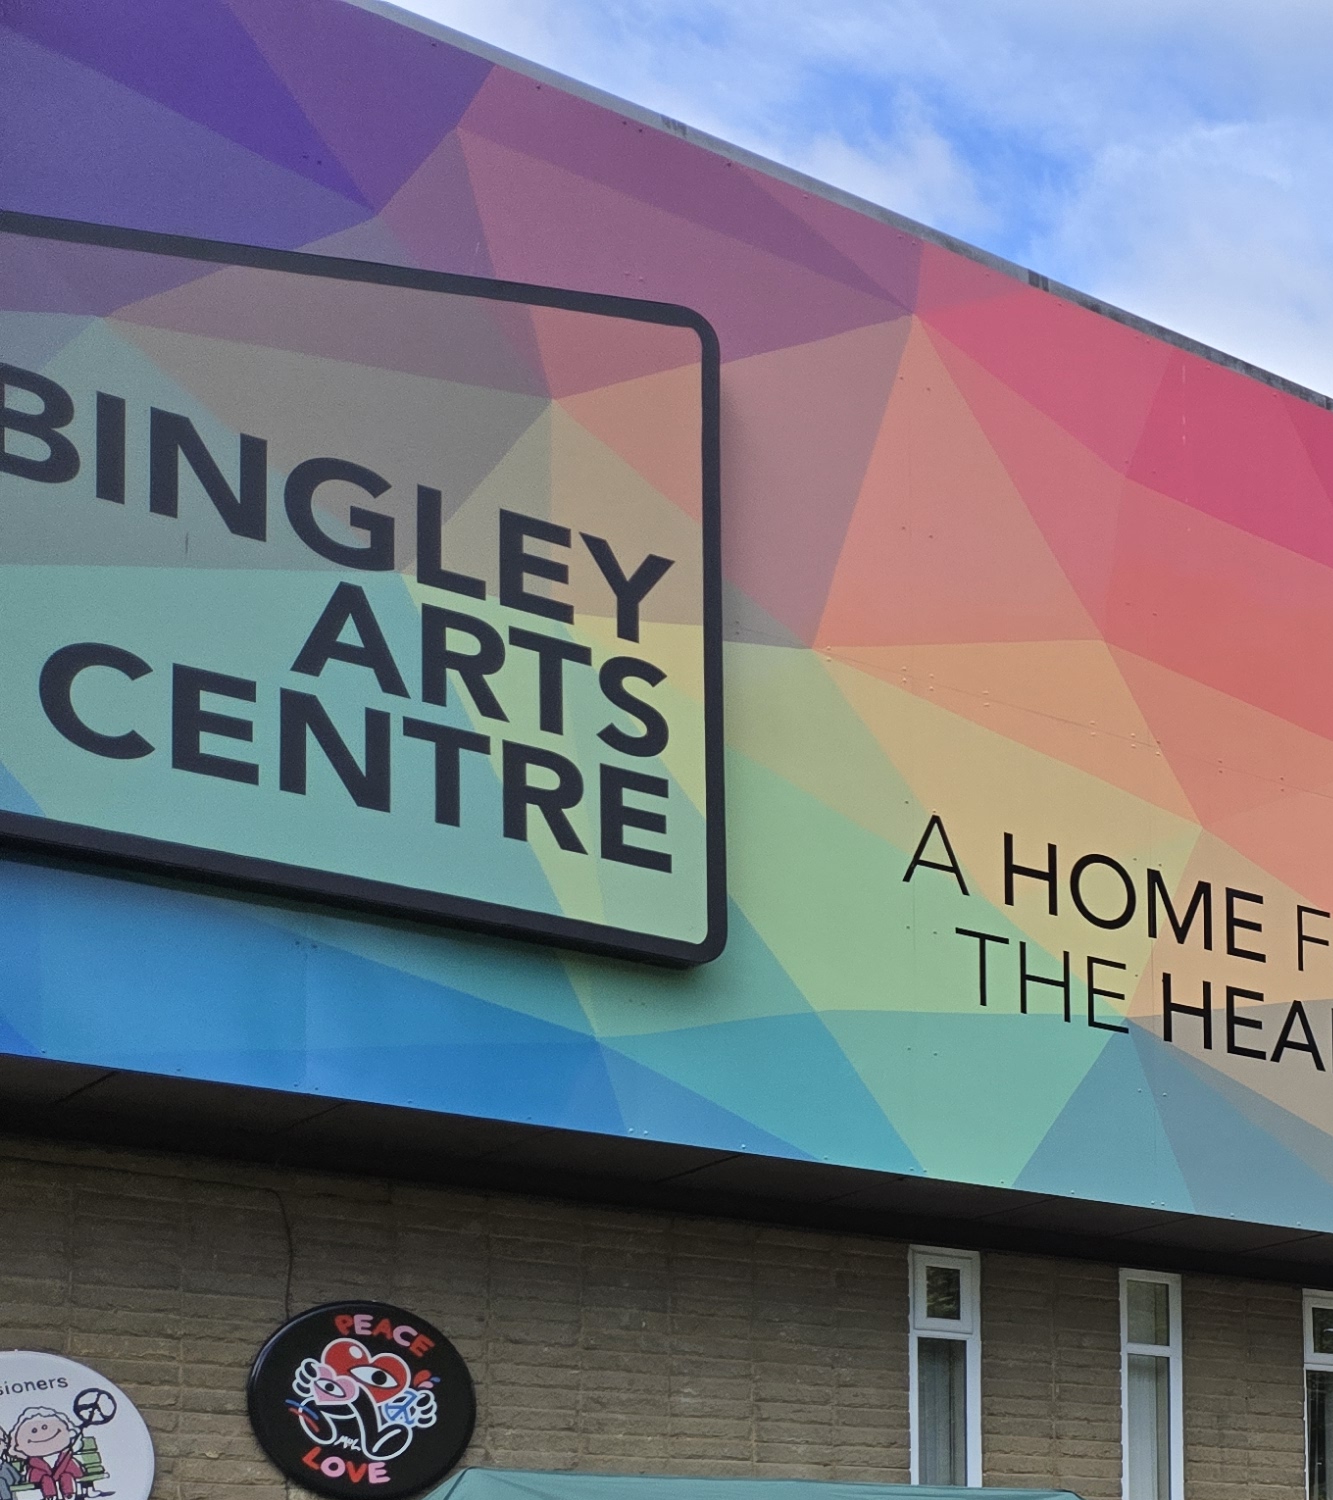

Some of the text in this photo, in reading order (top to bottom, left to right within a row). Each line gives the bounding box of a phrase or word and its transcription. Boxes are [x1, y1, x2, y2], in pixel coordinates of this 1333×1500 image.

[0, 361, 675, 643] BINGLEY
[291, 582, 669, 758] ARTS
[38, 642, 672, 874] CENTRE
[902, 814, 970, 897] A
[1003, 831, 1267, 964] HOME
[955, 926, 1129, 1035] THE
[0, 1376, 68, 1396] ioners
[334, 1314, 435, 1357] PEACE
[302, 1446, 391, 1484] LOVE
